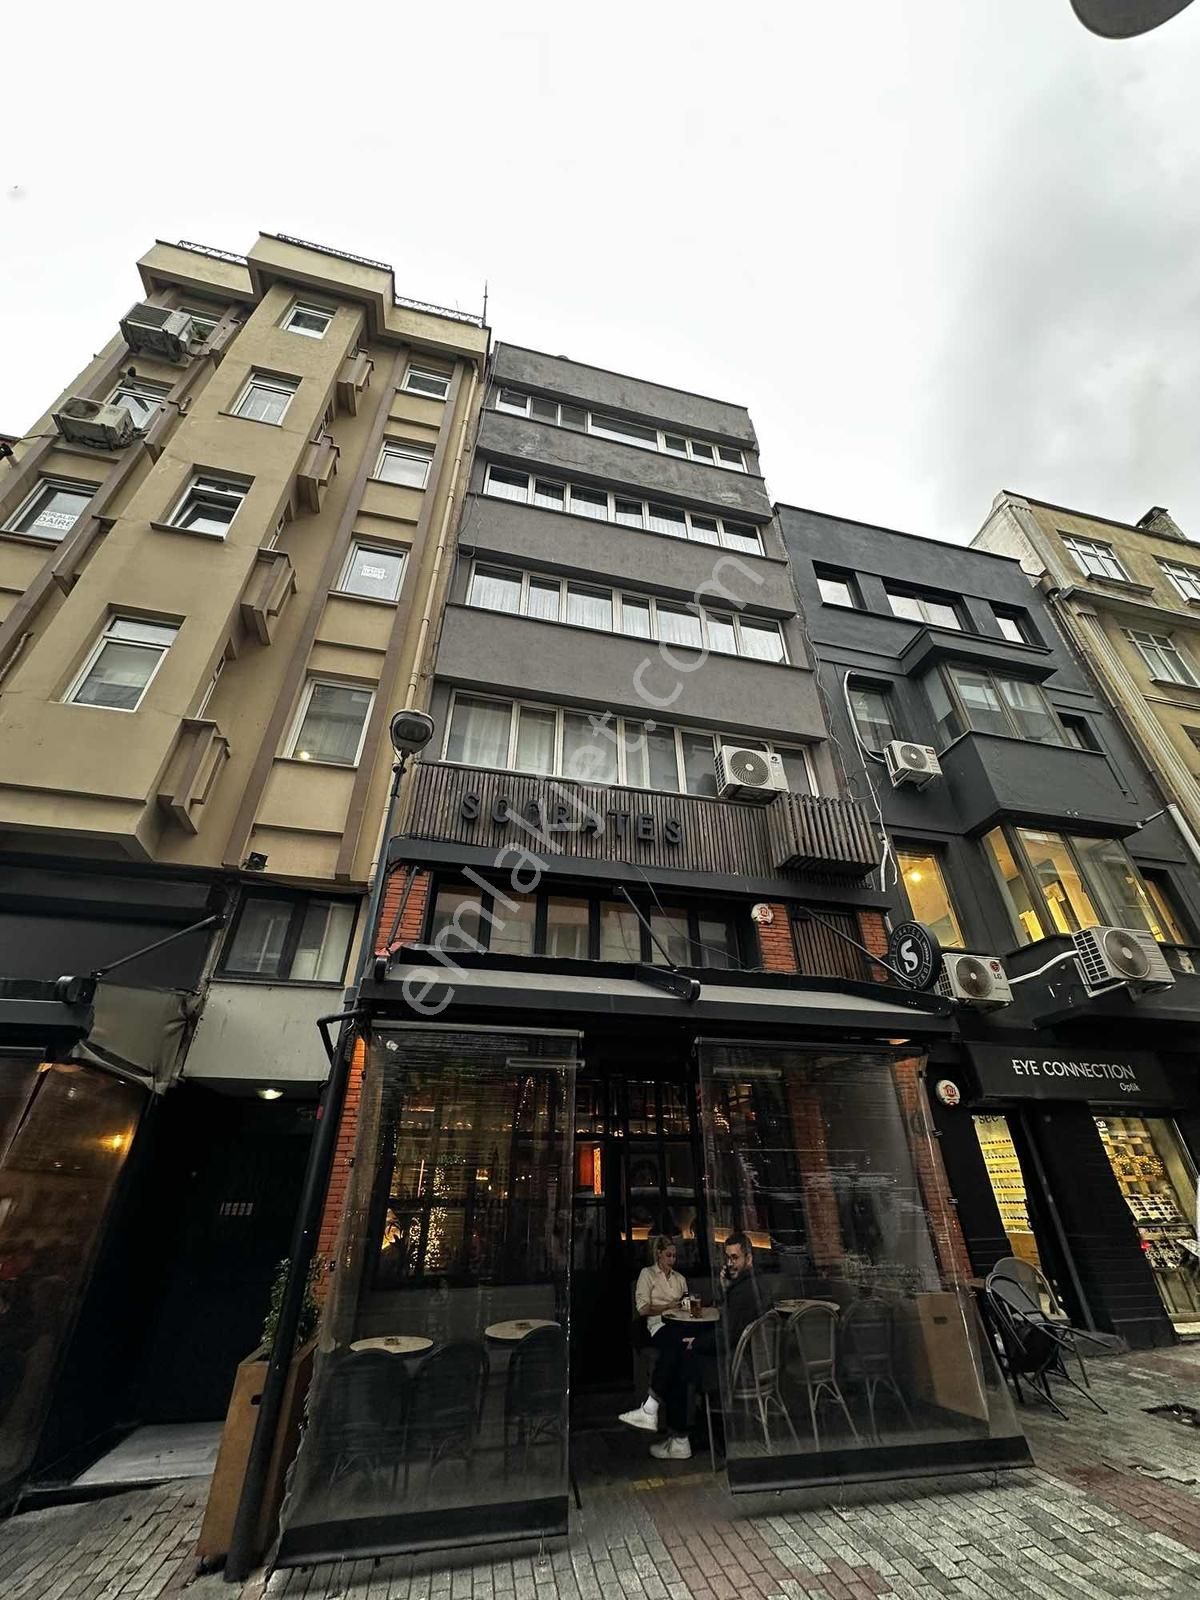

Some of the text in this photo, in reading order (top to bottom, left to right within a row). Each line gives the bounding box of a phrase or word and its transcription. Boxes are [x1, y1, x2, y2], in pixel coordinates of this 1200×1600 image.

[461, 791, 682, 845] SOCRATES
[1011, 1059, 1137, 1079] EYE CONNECTION
[1119, 1082, 1141, 1093] Optik
